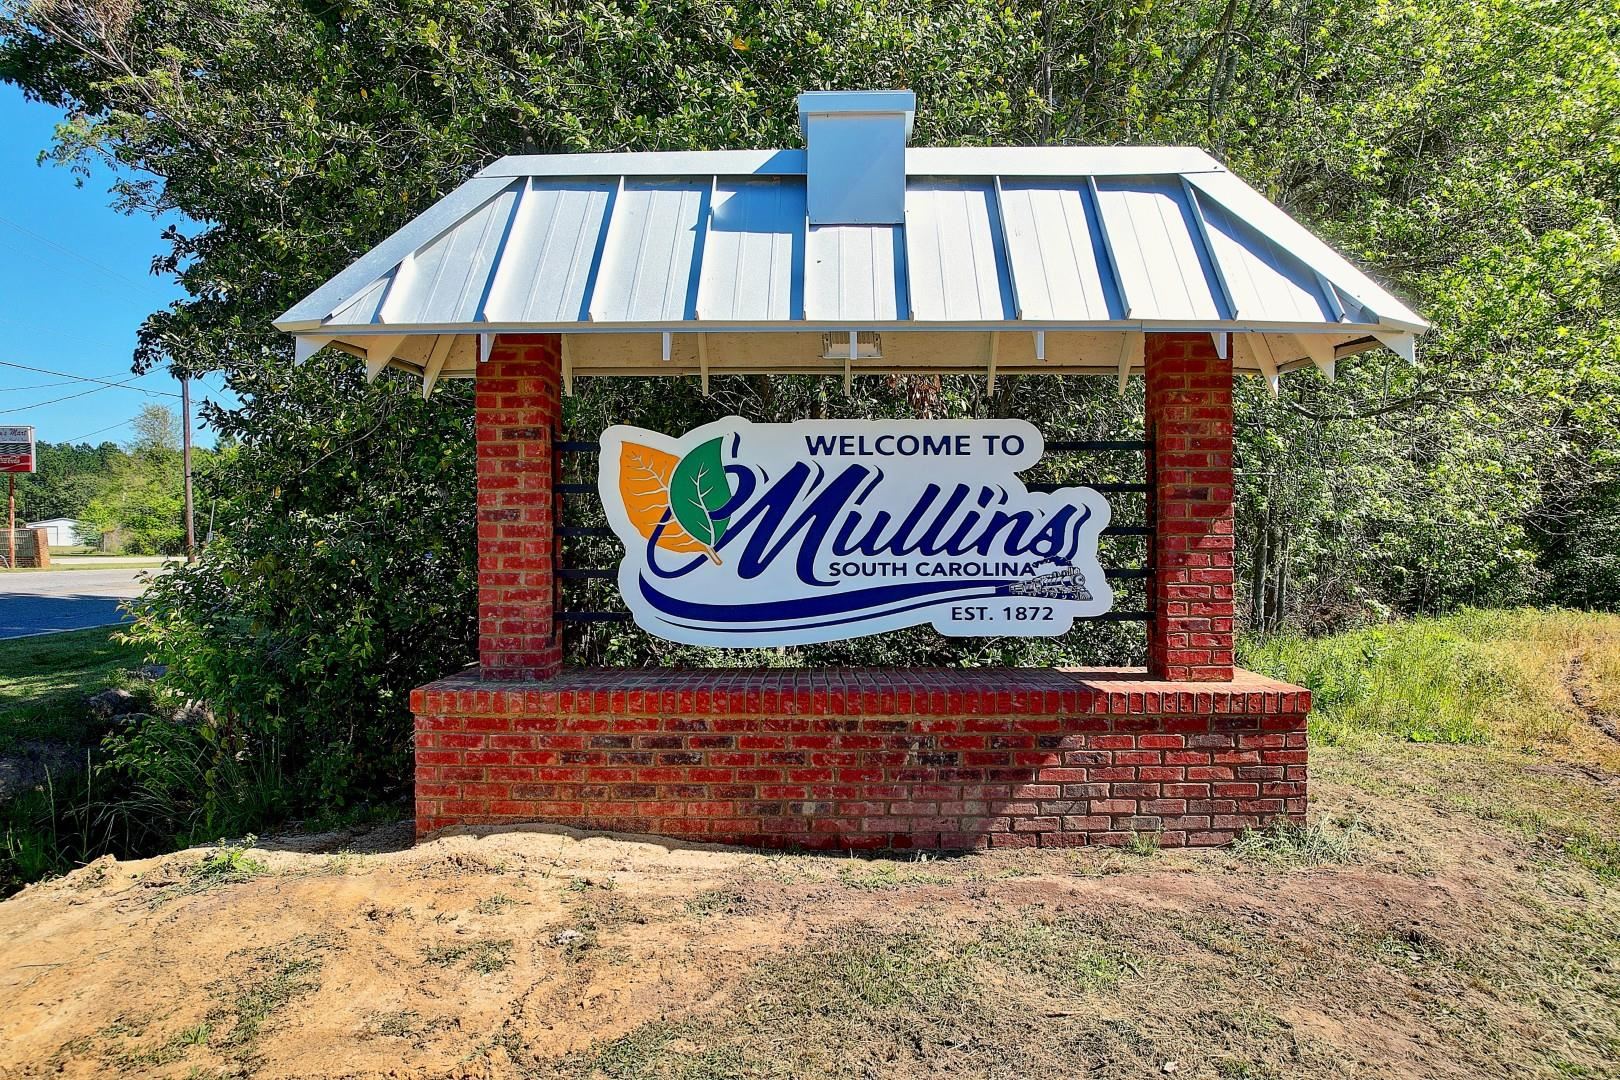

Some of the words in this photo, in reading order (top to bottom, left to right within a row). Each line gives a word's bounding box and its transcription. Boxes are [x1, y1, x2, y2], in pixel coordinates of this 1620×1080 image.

[805, 434, 971, 456] WELCOME
[982, 434, 1025, 456] TO
[650, 460, 1088, 586] Mullins
[829, 561, 908, 577] SOUTH
[915, 561, 1036, 577] CAROLINA
[951, 606, 994, 621] EST.
[1003, 606, 1054, 621] 1872
